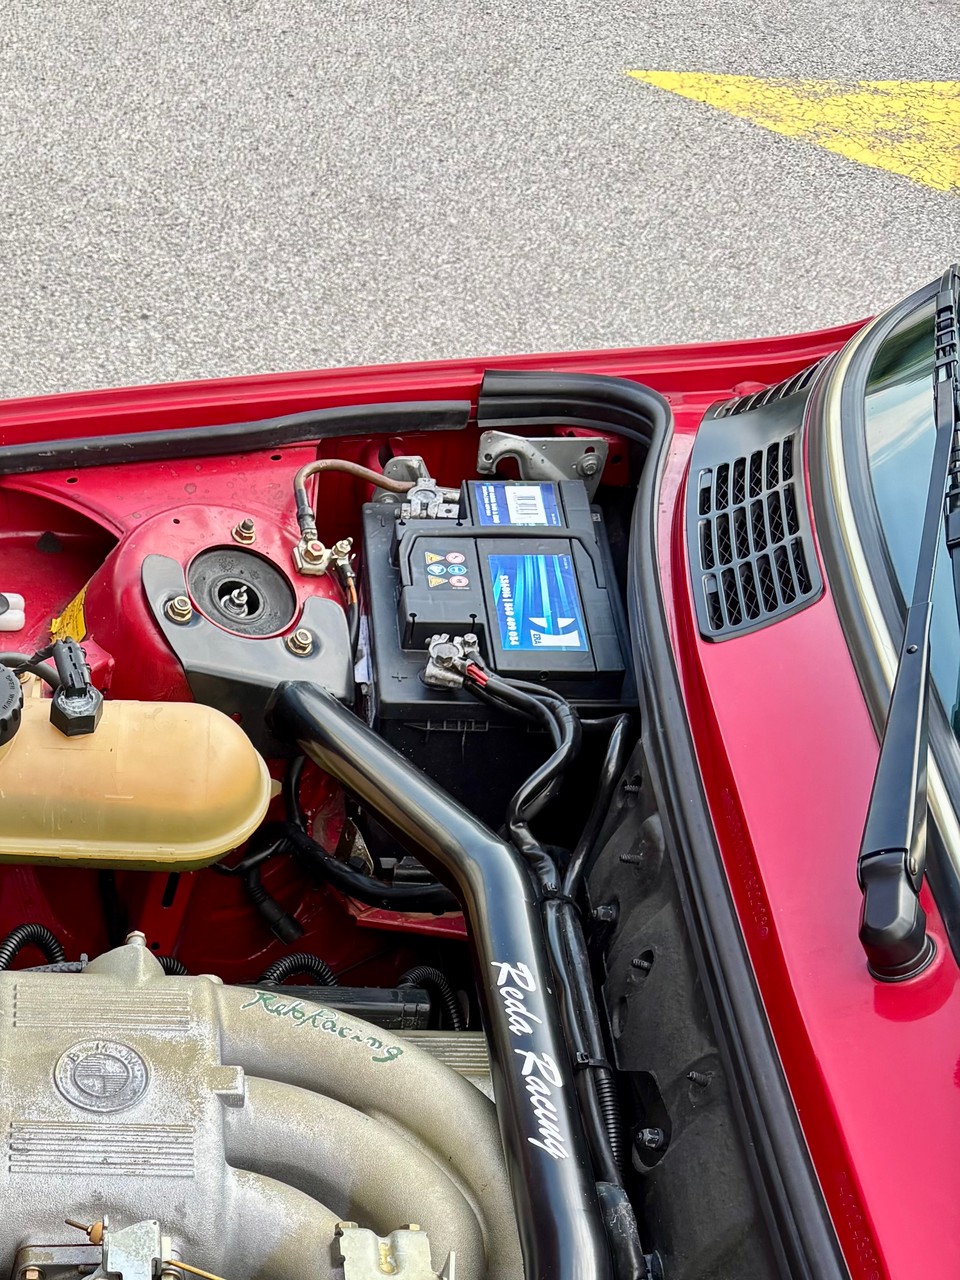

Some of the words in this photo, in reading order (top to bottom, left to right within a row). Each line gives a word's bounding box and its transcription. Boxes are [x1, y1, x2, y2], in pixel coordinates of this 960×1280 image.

[532, 633, 542, 645] ERA
[5, 674, 15, 690] OPEN
[490, 961, 543, 1037] Reda
[514, 1048, 569, 1160] Racing
